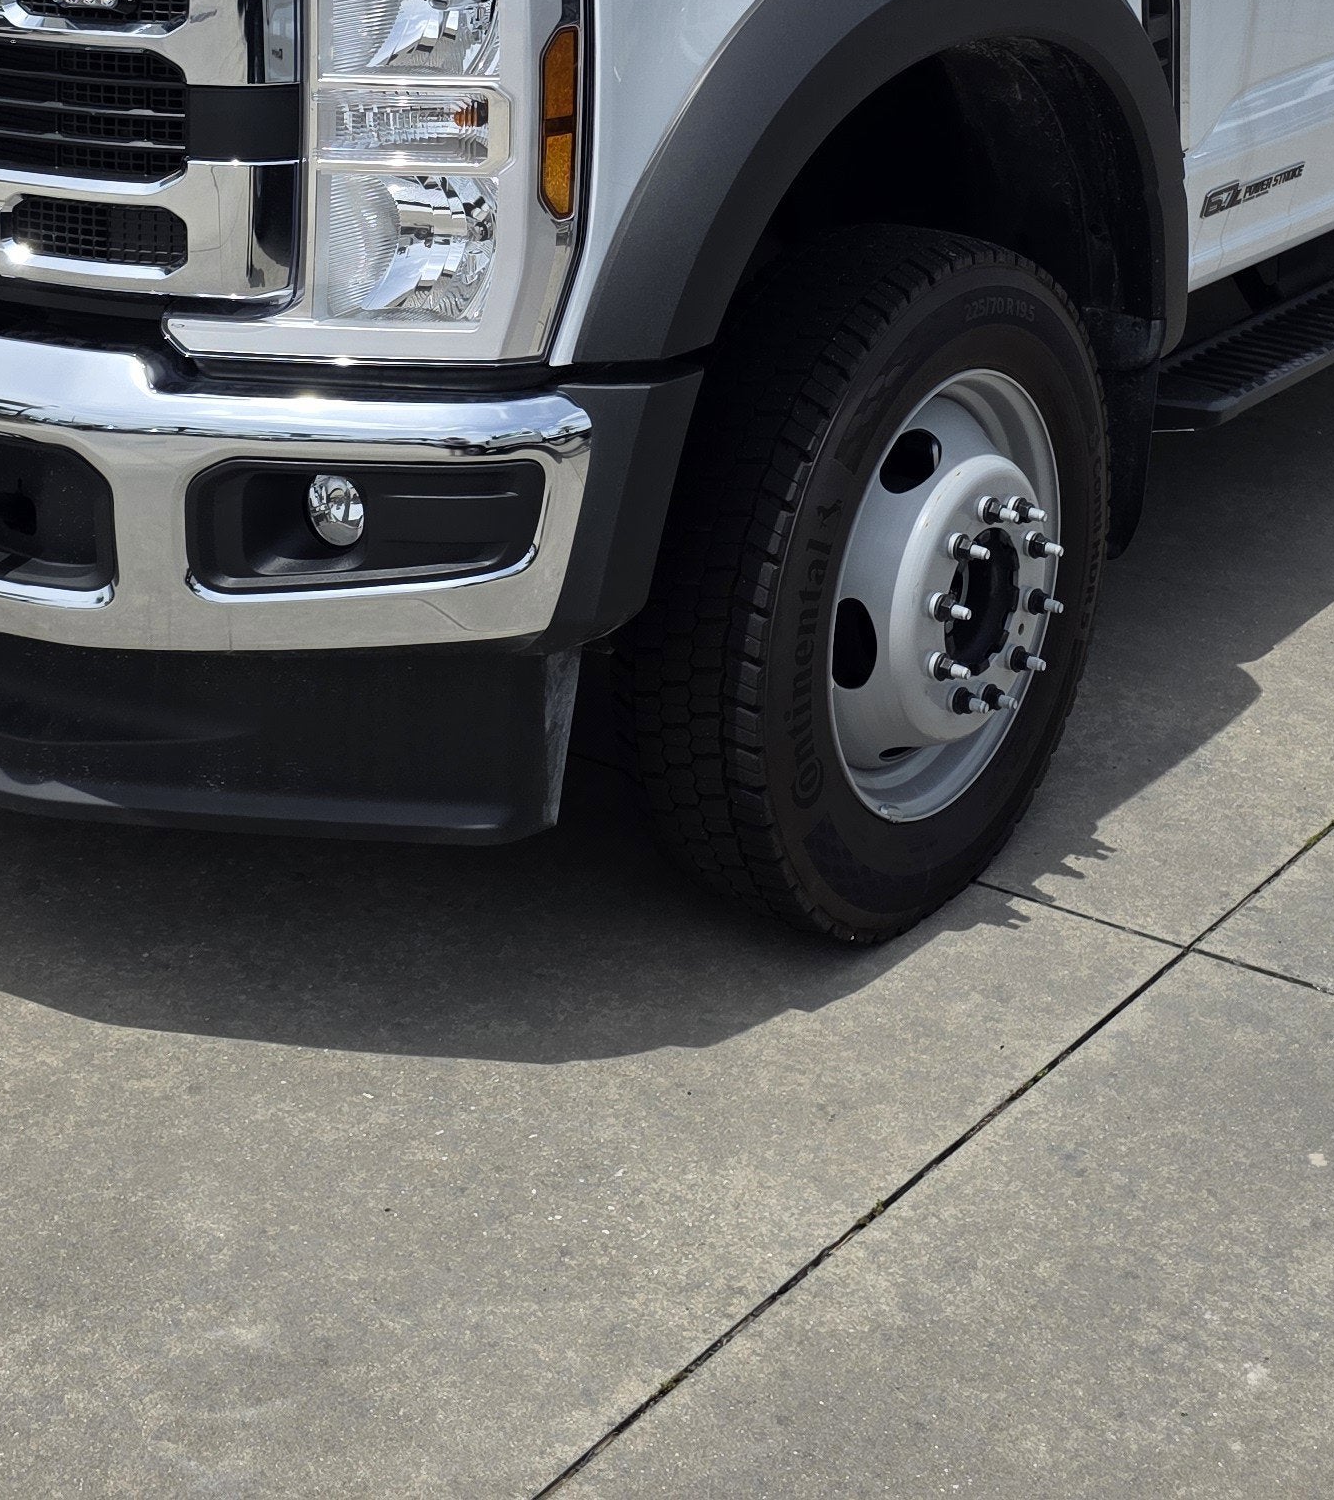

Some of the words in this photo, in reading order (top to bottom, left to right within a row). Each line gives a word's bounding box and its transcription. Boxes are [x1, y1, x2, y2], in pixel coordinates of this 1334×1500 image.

[1243, 176, 1273, 198] POWER
[1272, 164, 1305, 187] STROKE
[785, 536, 833, 811] Continental
